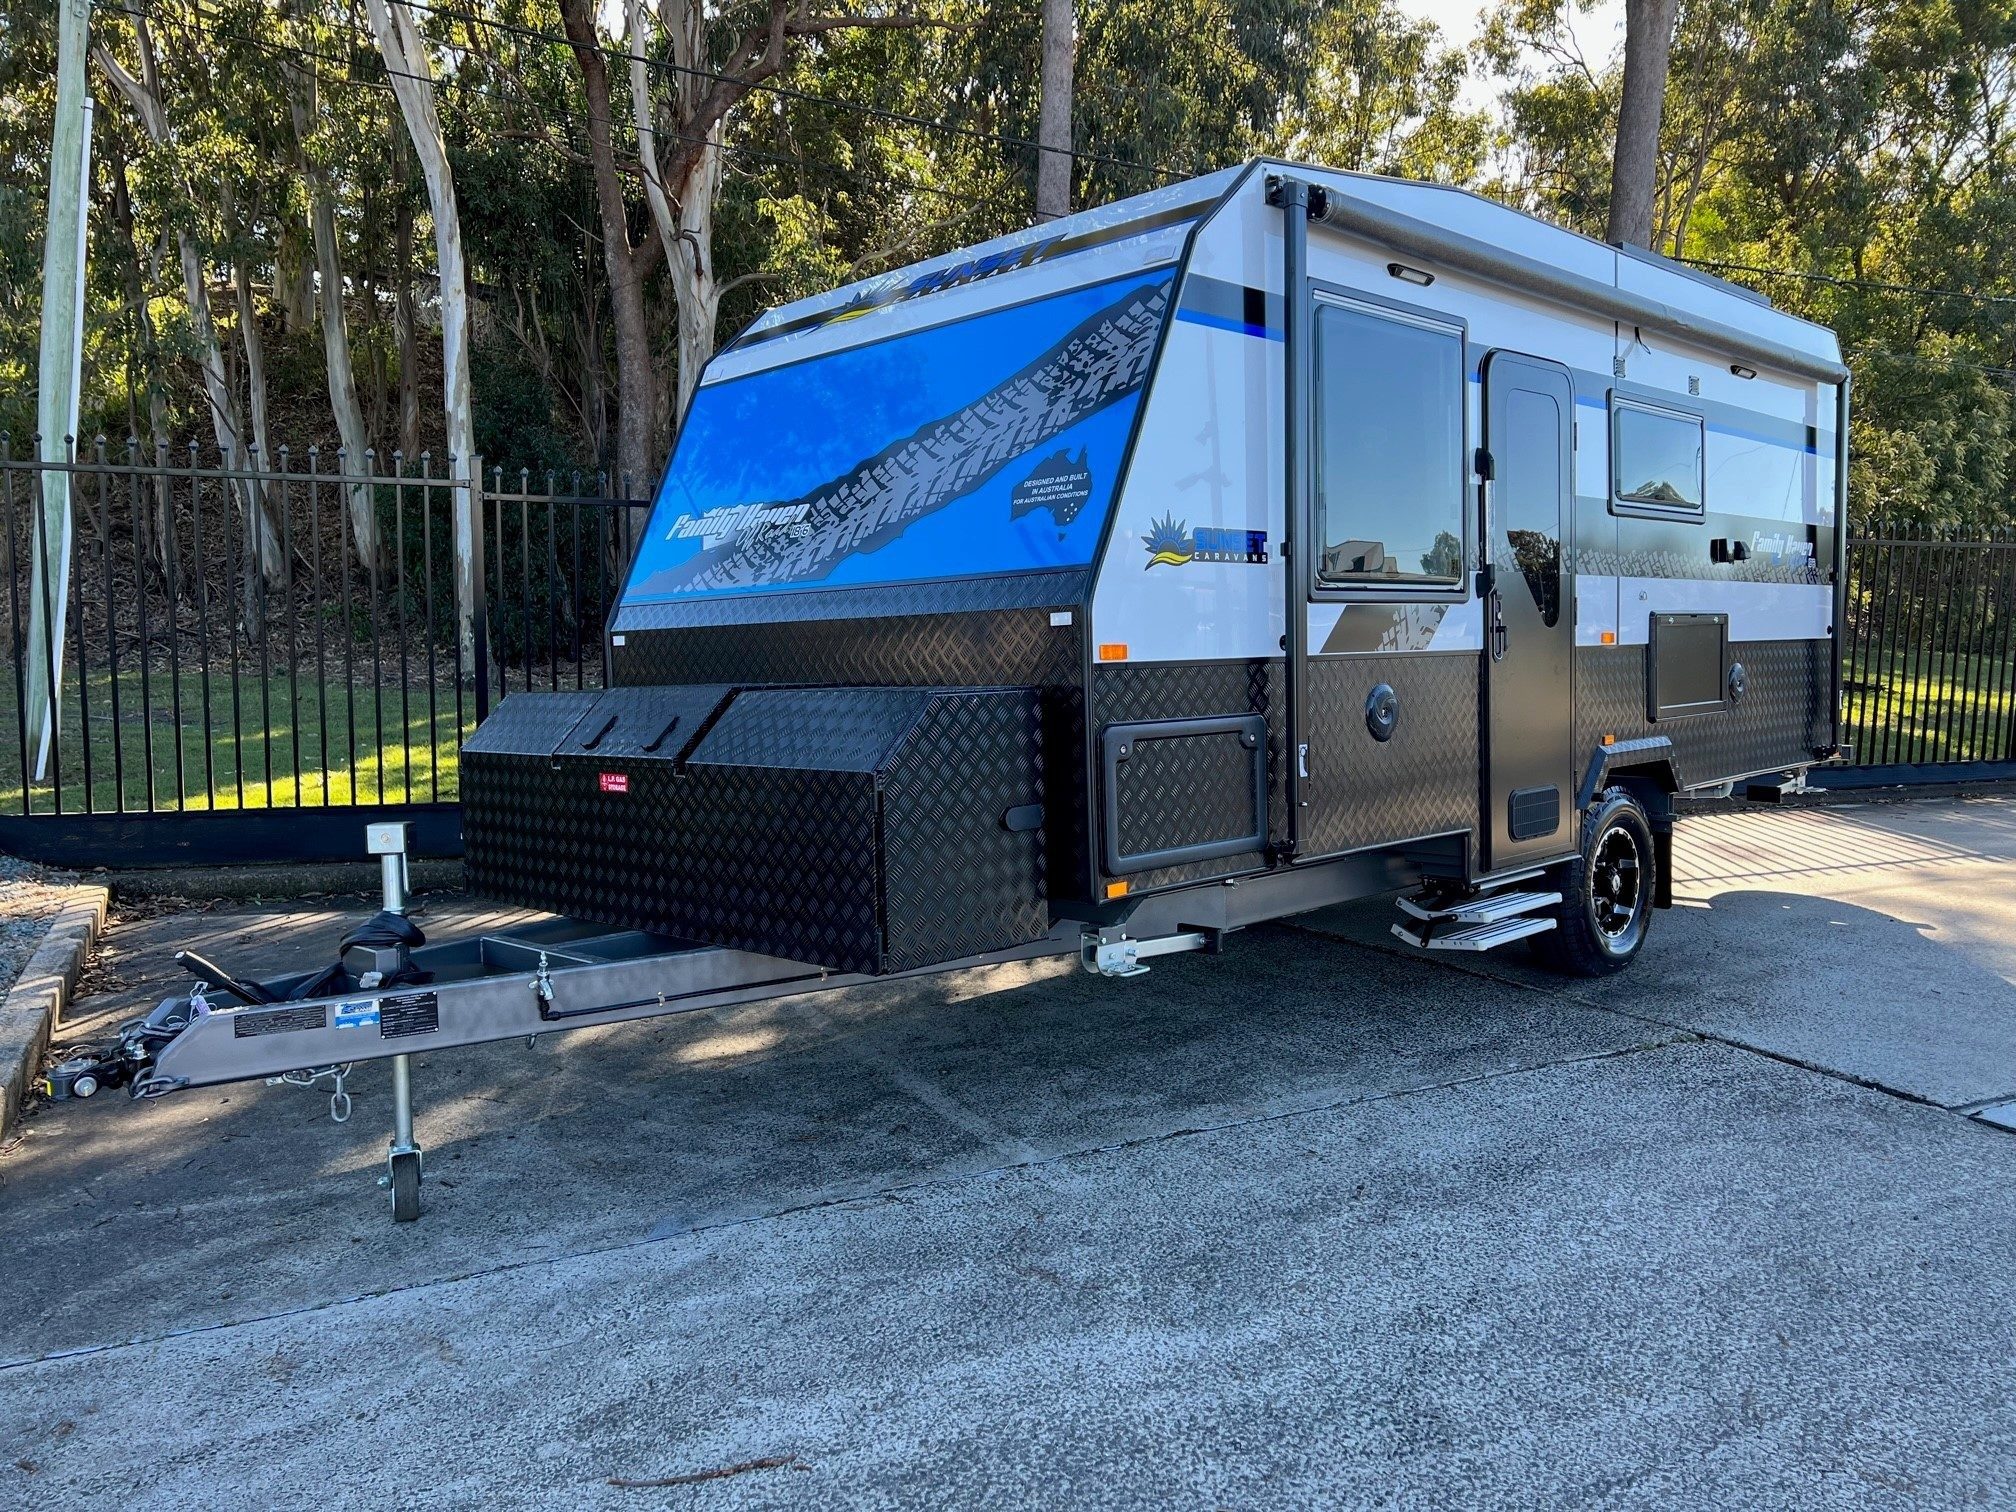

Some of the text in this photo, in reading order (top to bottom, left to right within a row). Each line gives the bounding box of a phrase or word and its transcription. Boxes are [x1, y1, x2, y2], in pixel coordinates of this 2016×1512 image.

[893, 256, 1044, 304] CARAVANS
[1023, 472, 1088, 488] DESIGNED AND BUILT
[1039, 483, 1073, 494] AUSTRALIA
[1024, 494, 1056, 504] AUSTRALIAN
[1056, 490, 1089, 500] CONDITIONS
[665, 502, 811, 541] Family Haven
[1194, 530, 1267, 552] SUNSET
[1750, 530, 1814, 559] Family Haven
[1194, 552, 1267, 563] CARAVANS
